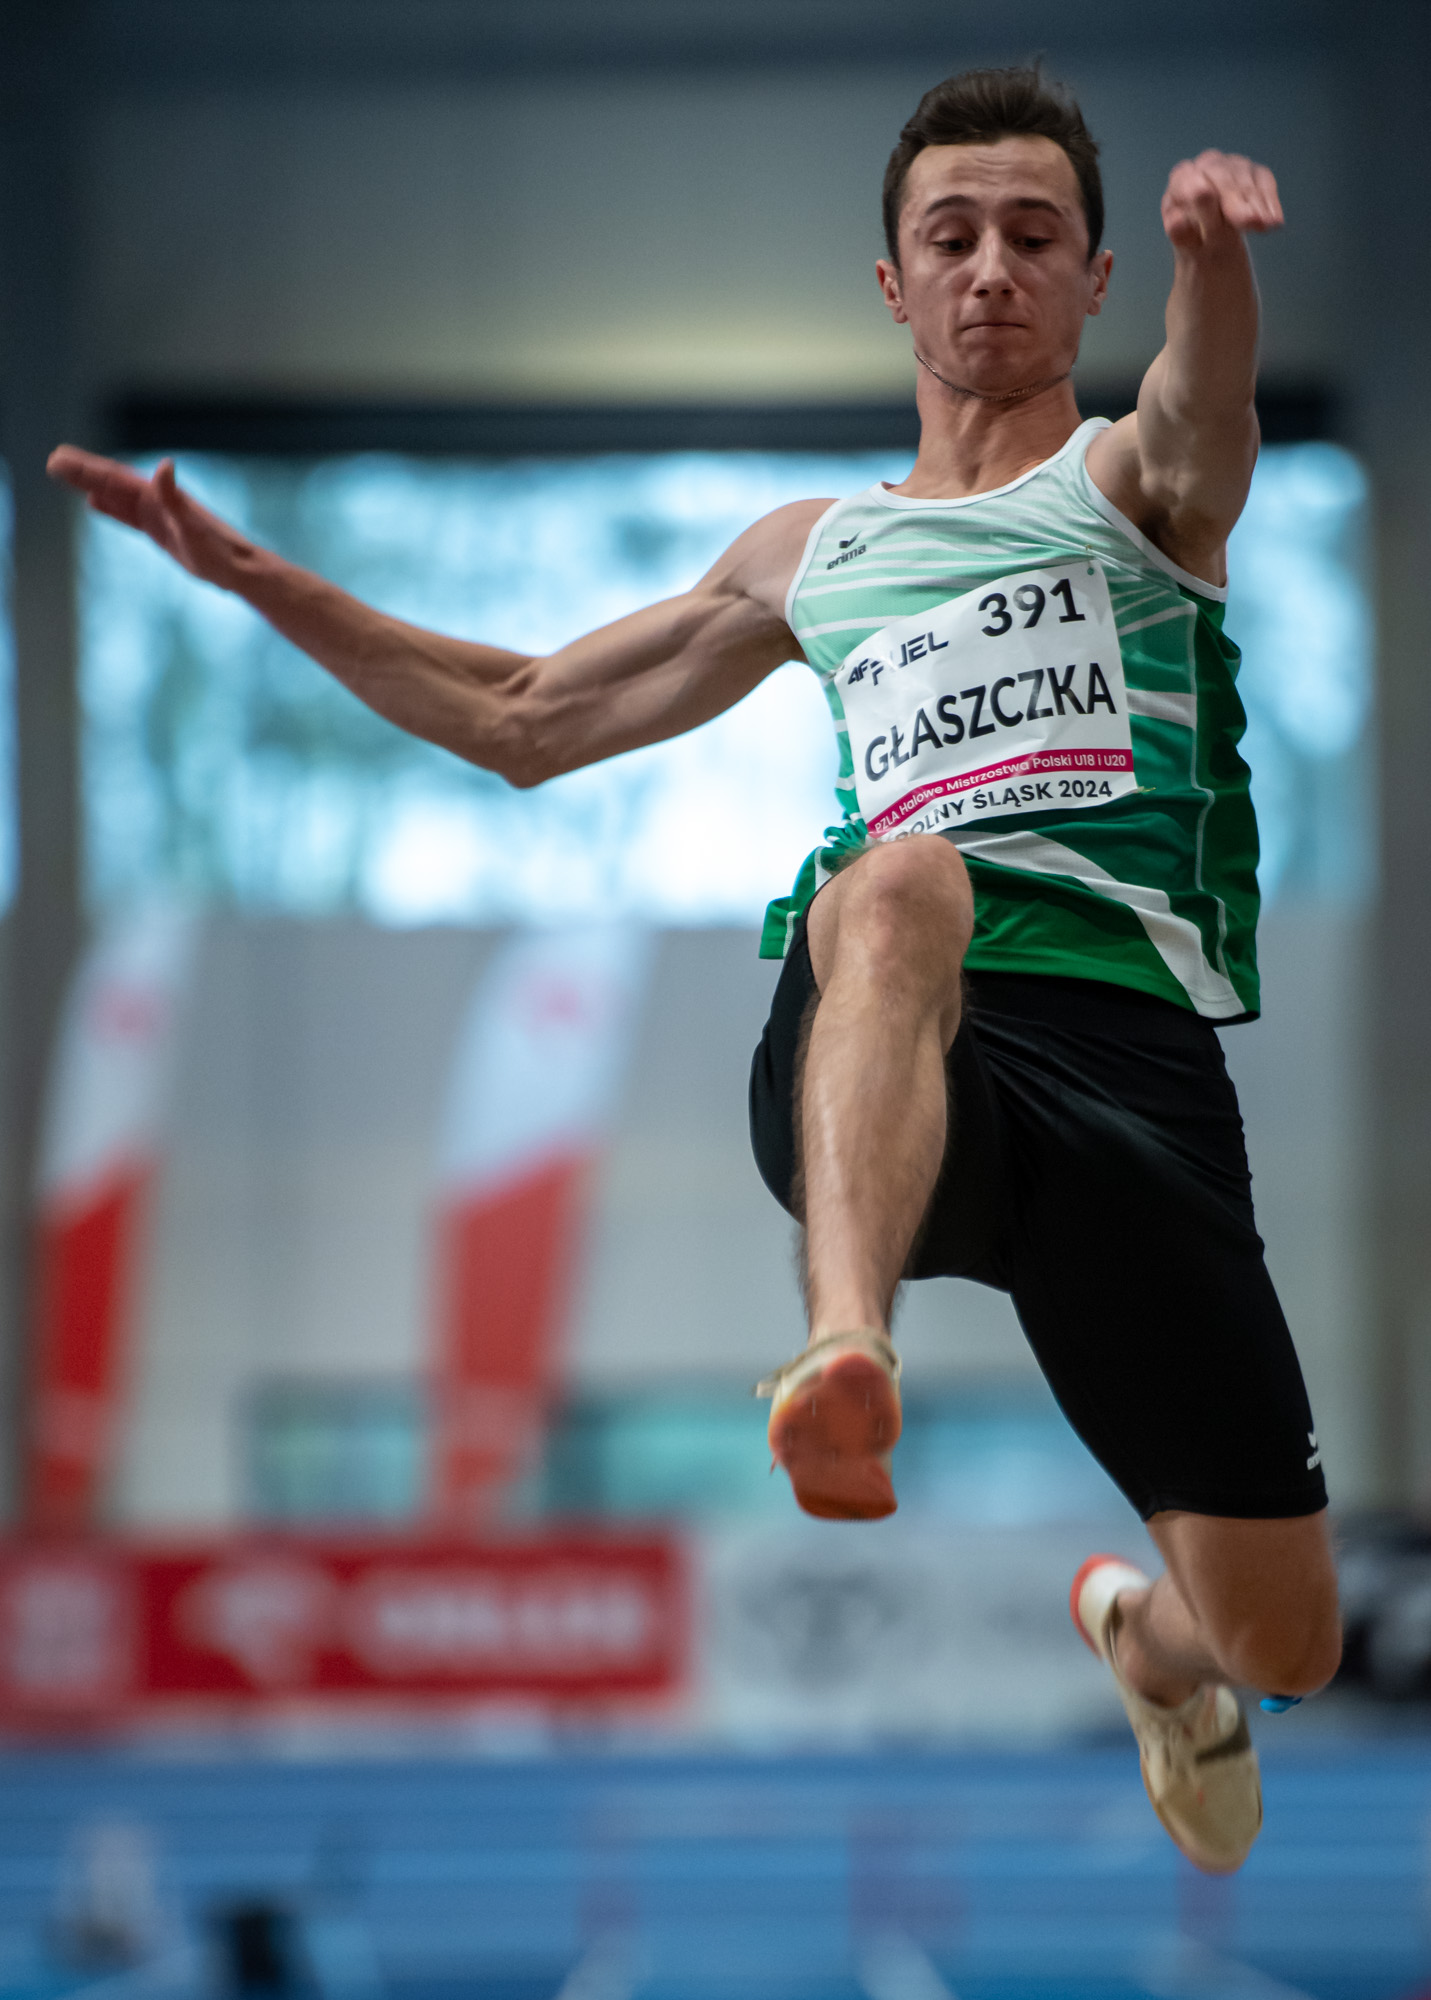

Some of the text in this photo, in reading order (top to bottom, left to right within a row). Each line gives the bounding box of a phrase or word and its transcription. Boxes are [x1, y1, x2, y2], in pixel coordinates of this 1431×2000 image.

[827, 543, 867, 570] erima
[977, 578, 1087, 638] 391
[864, 662, 1118, 782] GŁASZCZKA
[874, 810, 900, 833] PZLA
[898, 785, 944, 816] Halowe
[946, 759, 1031, 792] Mistrzostwa
[1033, 754, 1072, 768] Polski
[1074, 754, 1095, 767] U18
[1103, 754, 1127, 767] U20
[972, 781, 1053, 809] ŚLĄSK
[1058, 779, 1113, 799] 2024
